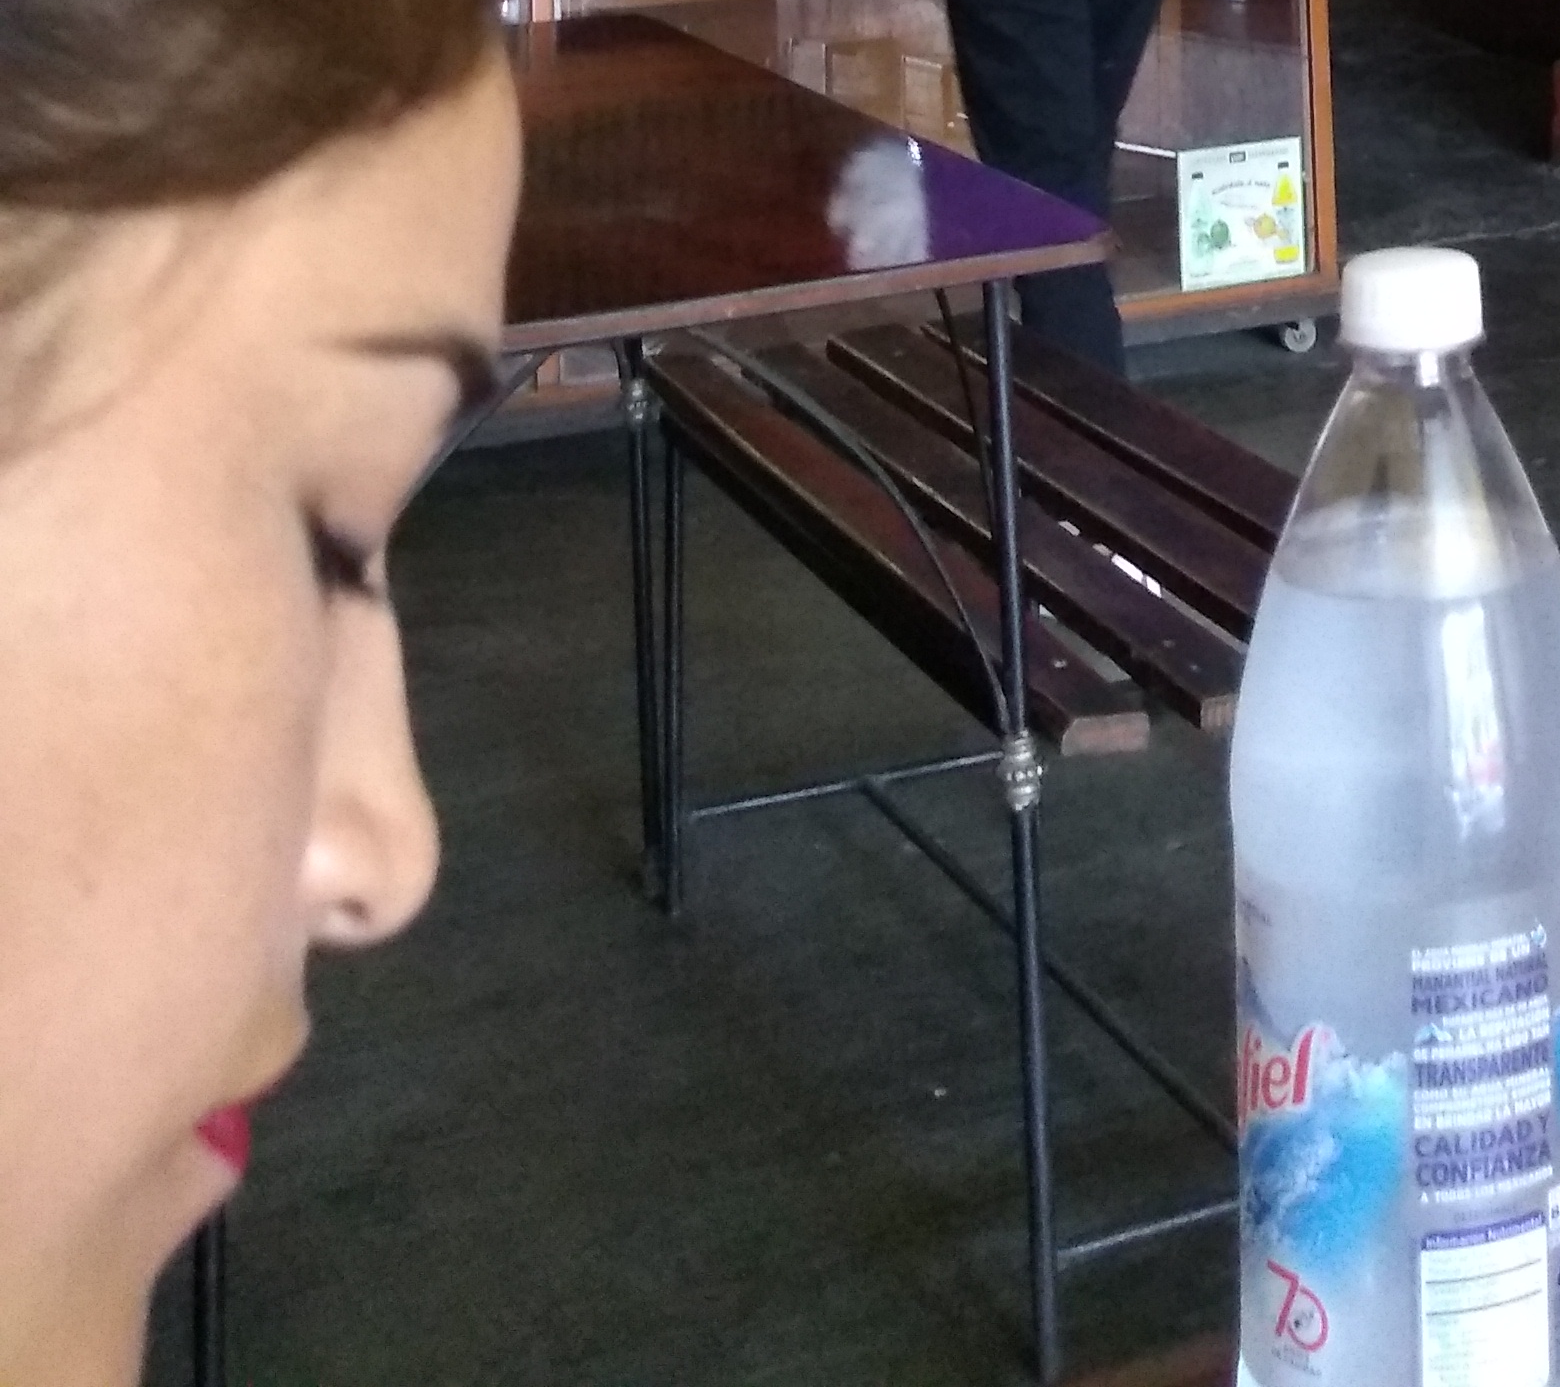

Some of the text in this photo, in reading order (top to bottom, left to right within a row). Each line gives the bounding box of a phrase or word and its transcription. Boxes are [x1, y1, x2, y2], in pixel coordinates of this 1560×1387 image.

[1411, 972, 1549, 1014] MEXICANO
[1414, 1038, 1550, 1088] TRANSPARENTE
[1414, 1109, 1551, 1158] CALIDAD Y
[1415, 1139, 1551, 1188] CONFIANZA
